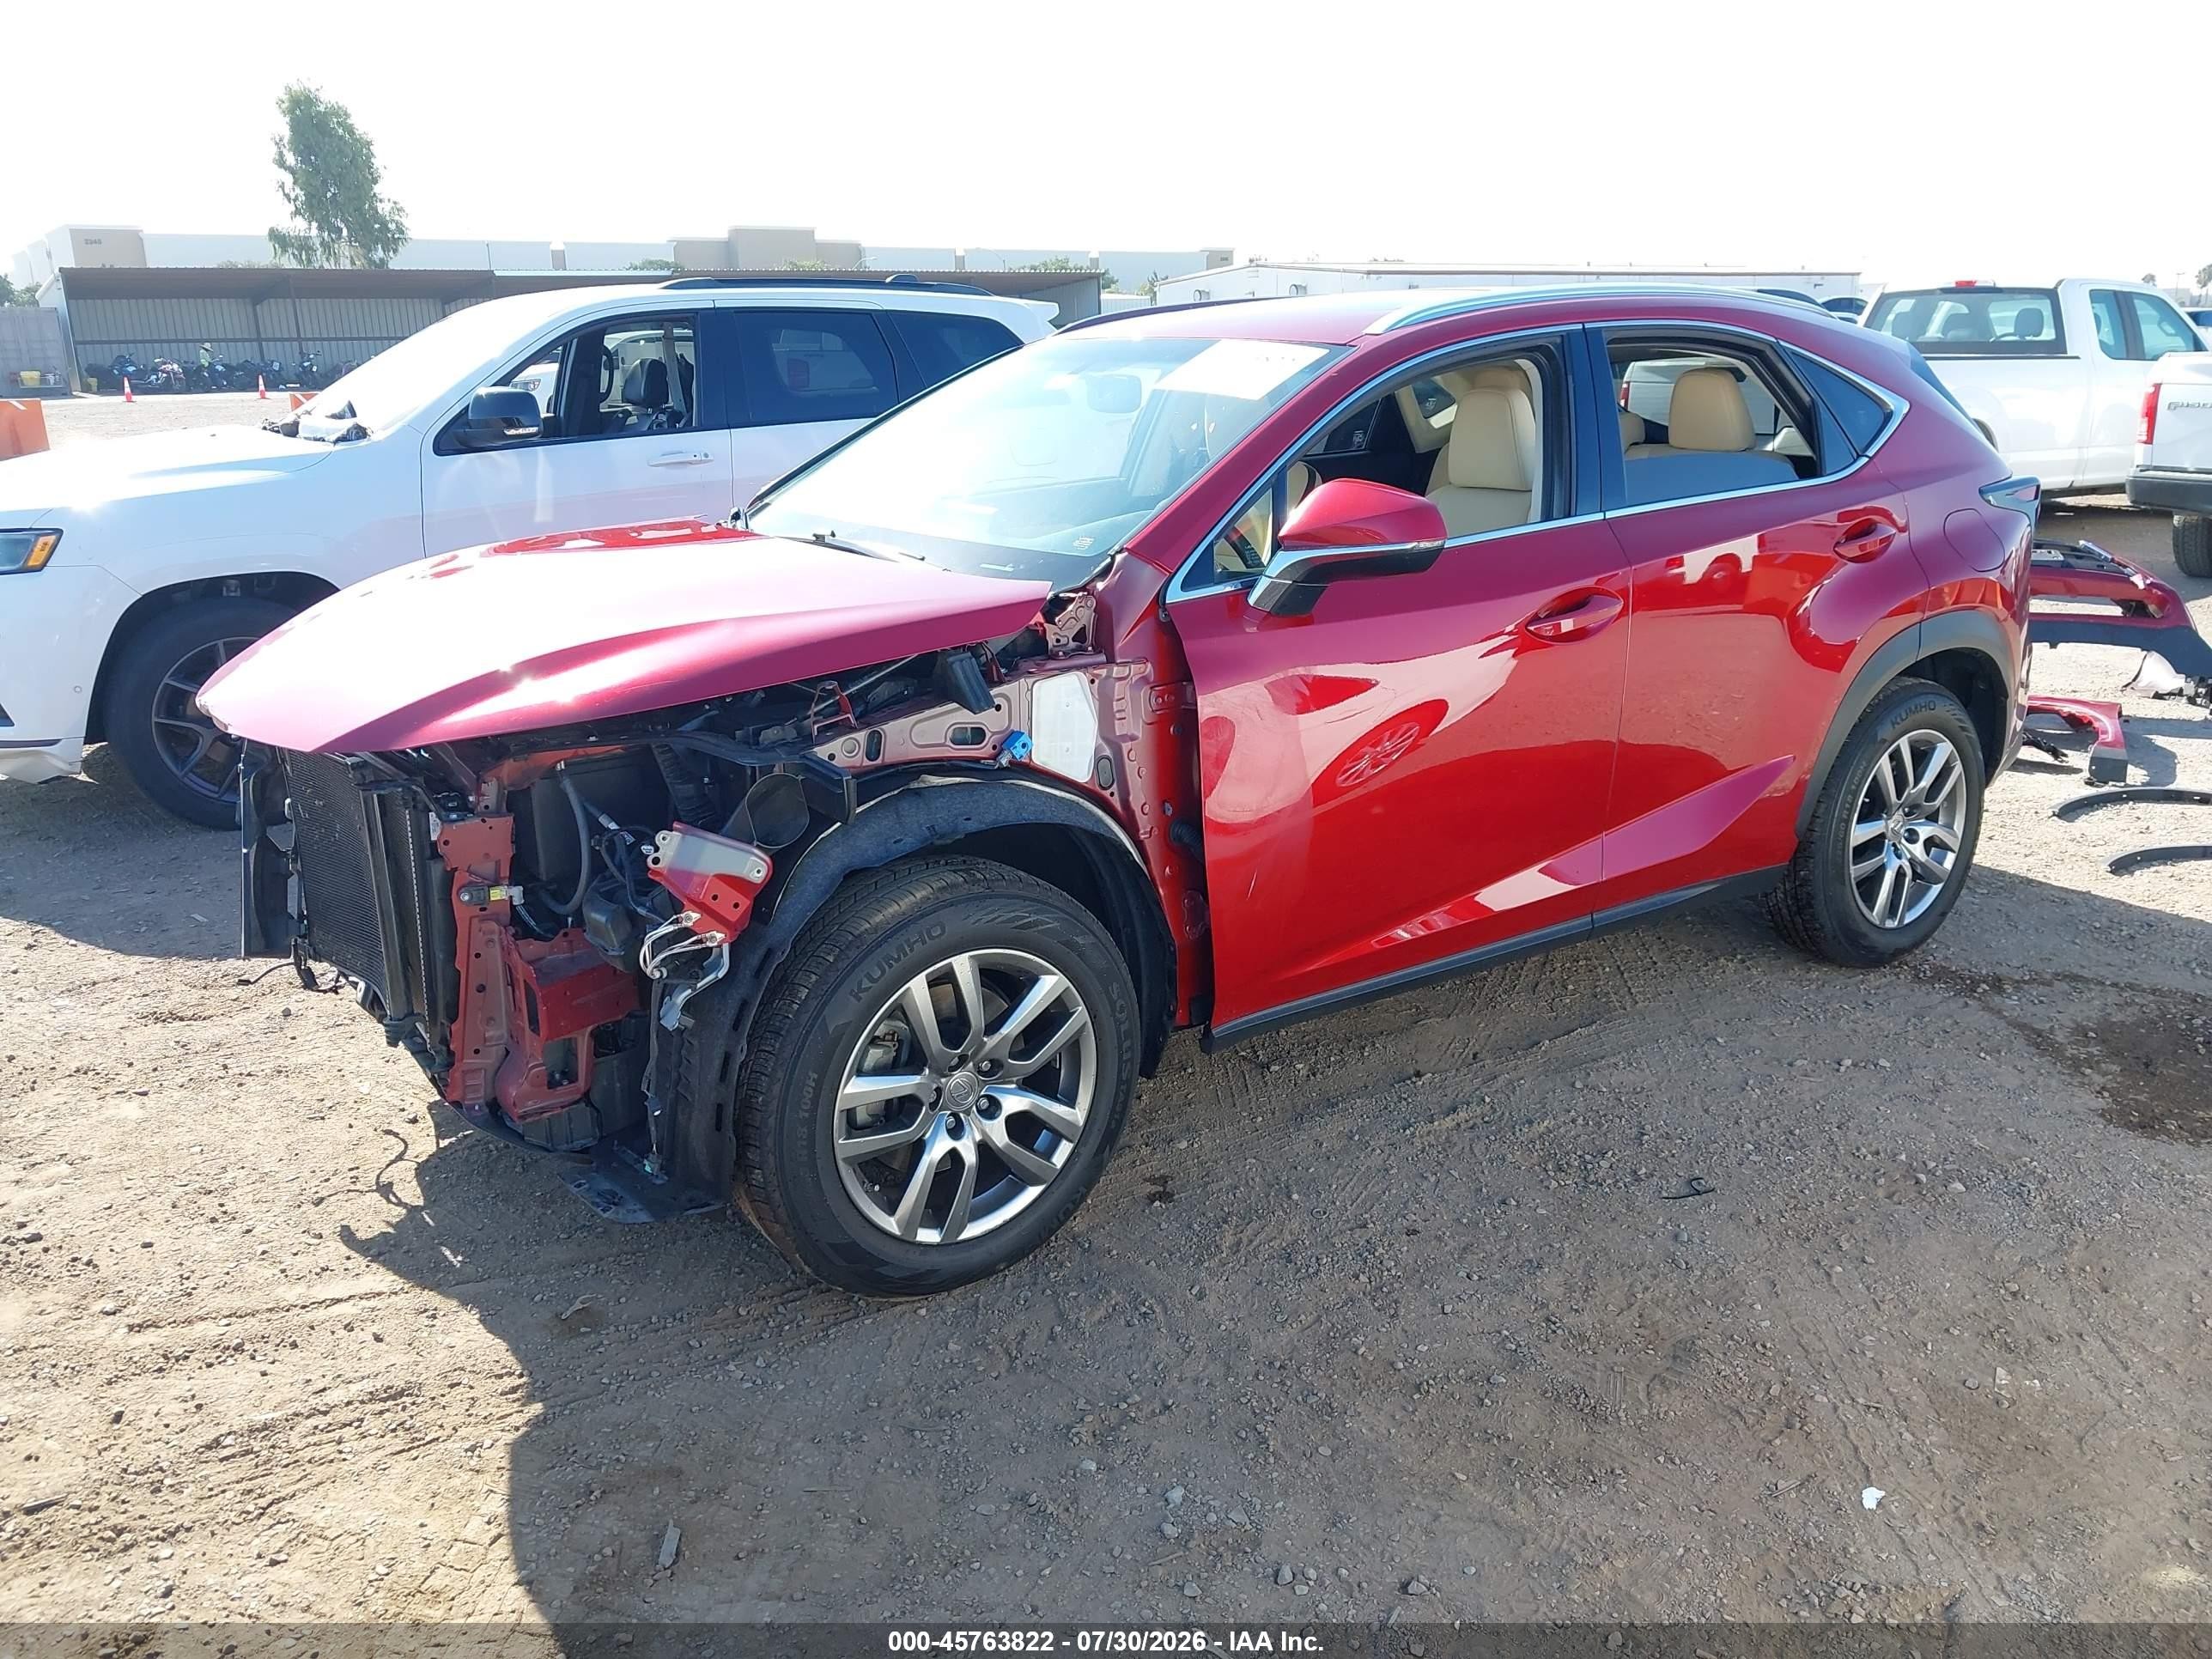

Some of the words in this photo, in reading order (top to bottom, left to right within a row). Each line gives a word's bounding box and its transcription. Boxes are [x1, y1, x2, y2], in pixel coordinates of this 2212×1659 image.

[1890, 700, 1936, 729] KUMHO
[849, 921, 947, 1003] KUMHO
[798, 1071, 818, 1120] 100H
